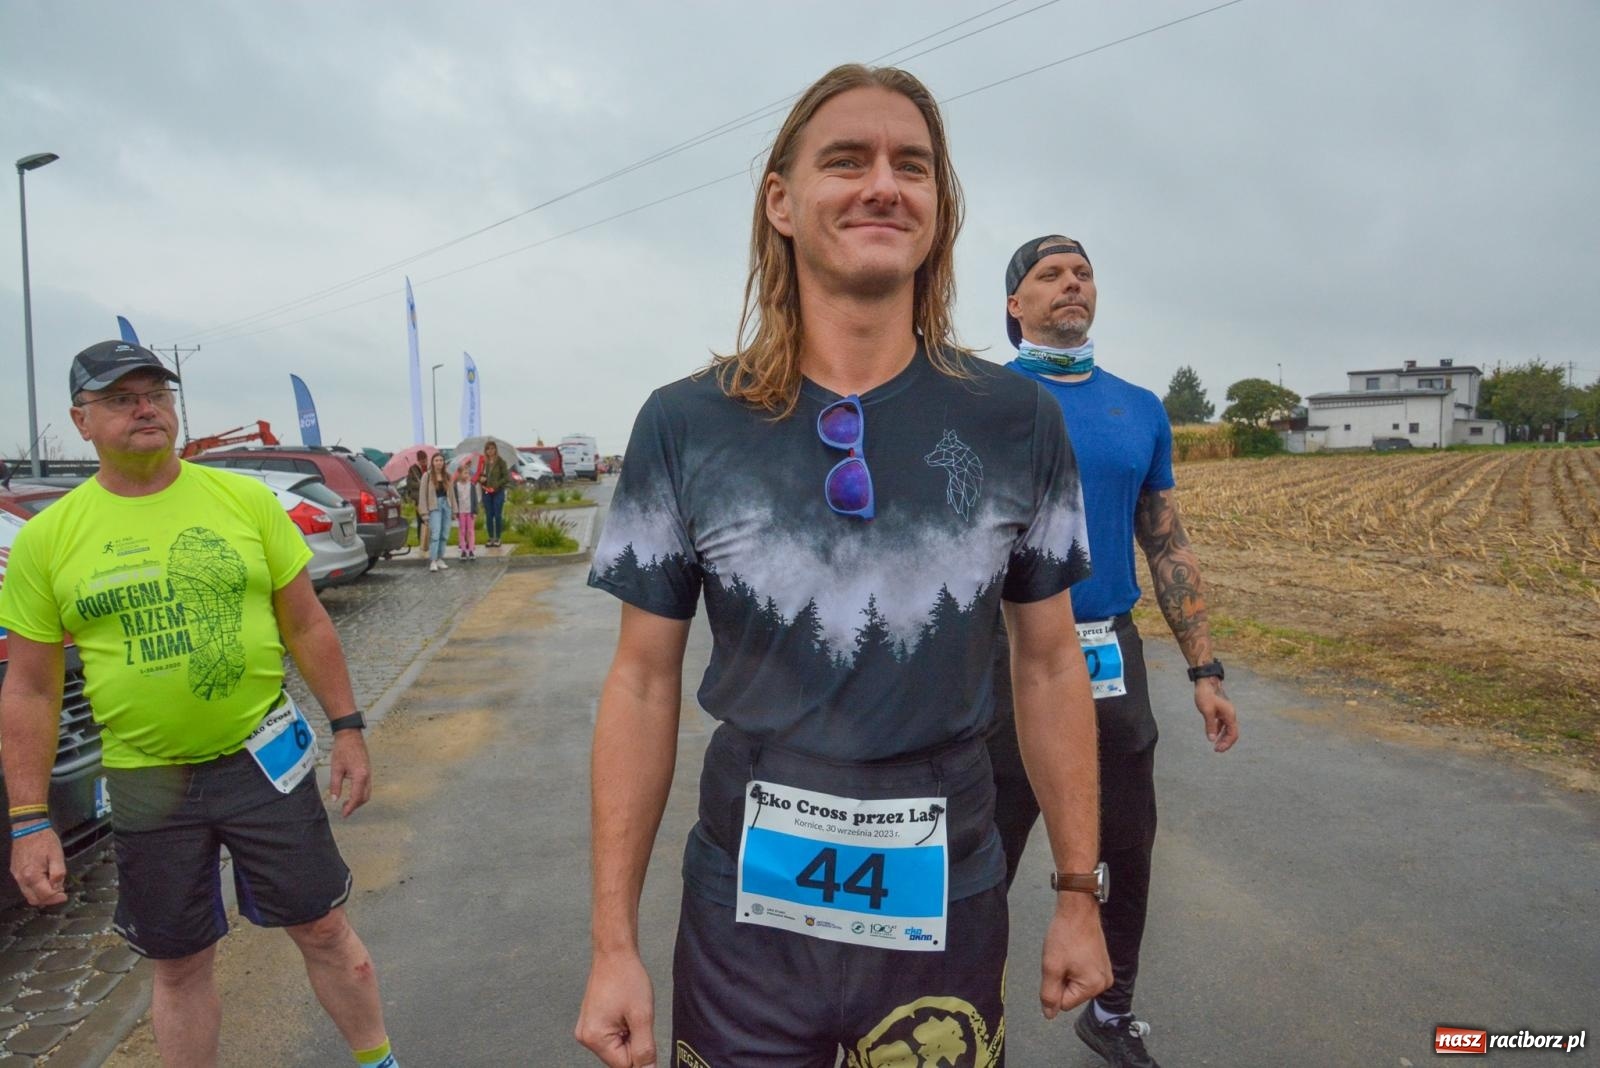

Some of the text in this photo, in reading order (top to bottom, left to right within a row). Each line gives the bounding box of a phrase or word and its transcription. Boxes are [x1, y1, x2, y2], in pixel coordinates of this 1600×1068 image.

[76, 578, 175, 621] POBIEGNIJ
[120, 602, 187, 637] RAZEM
[124, 629, 194, 666] Z NAMI
[293, 720, 309, 750] 6
[757, 791, 937, 826] Eko Cross przez Las
[794, 818, 824, 831] Kornice,
[826, 824, 836, 832] 30
[837, 827, 872, 837] września
[795, 847, 889, 910] 44
